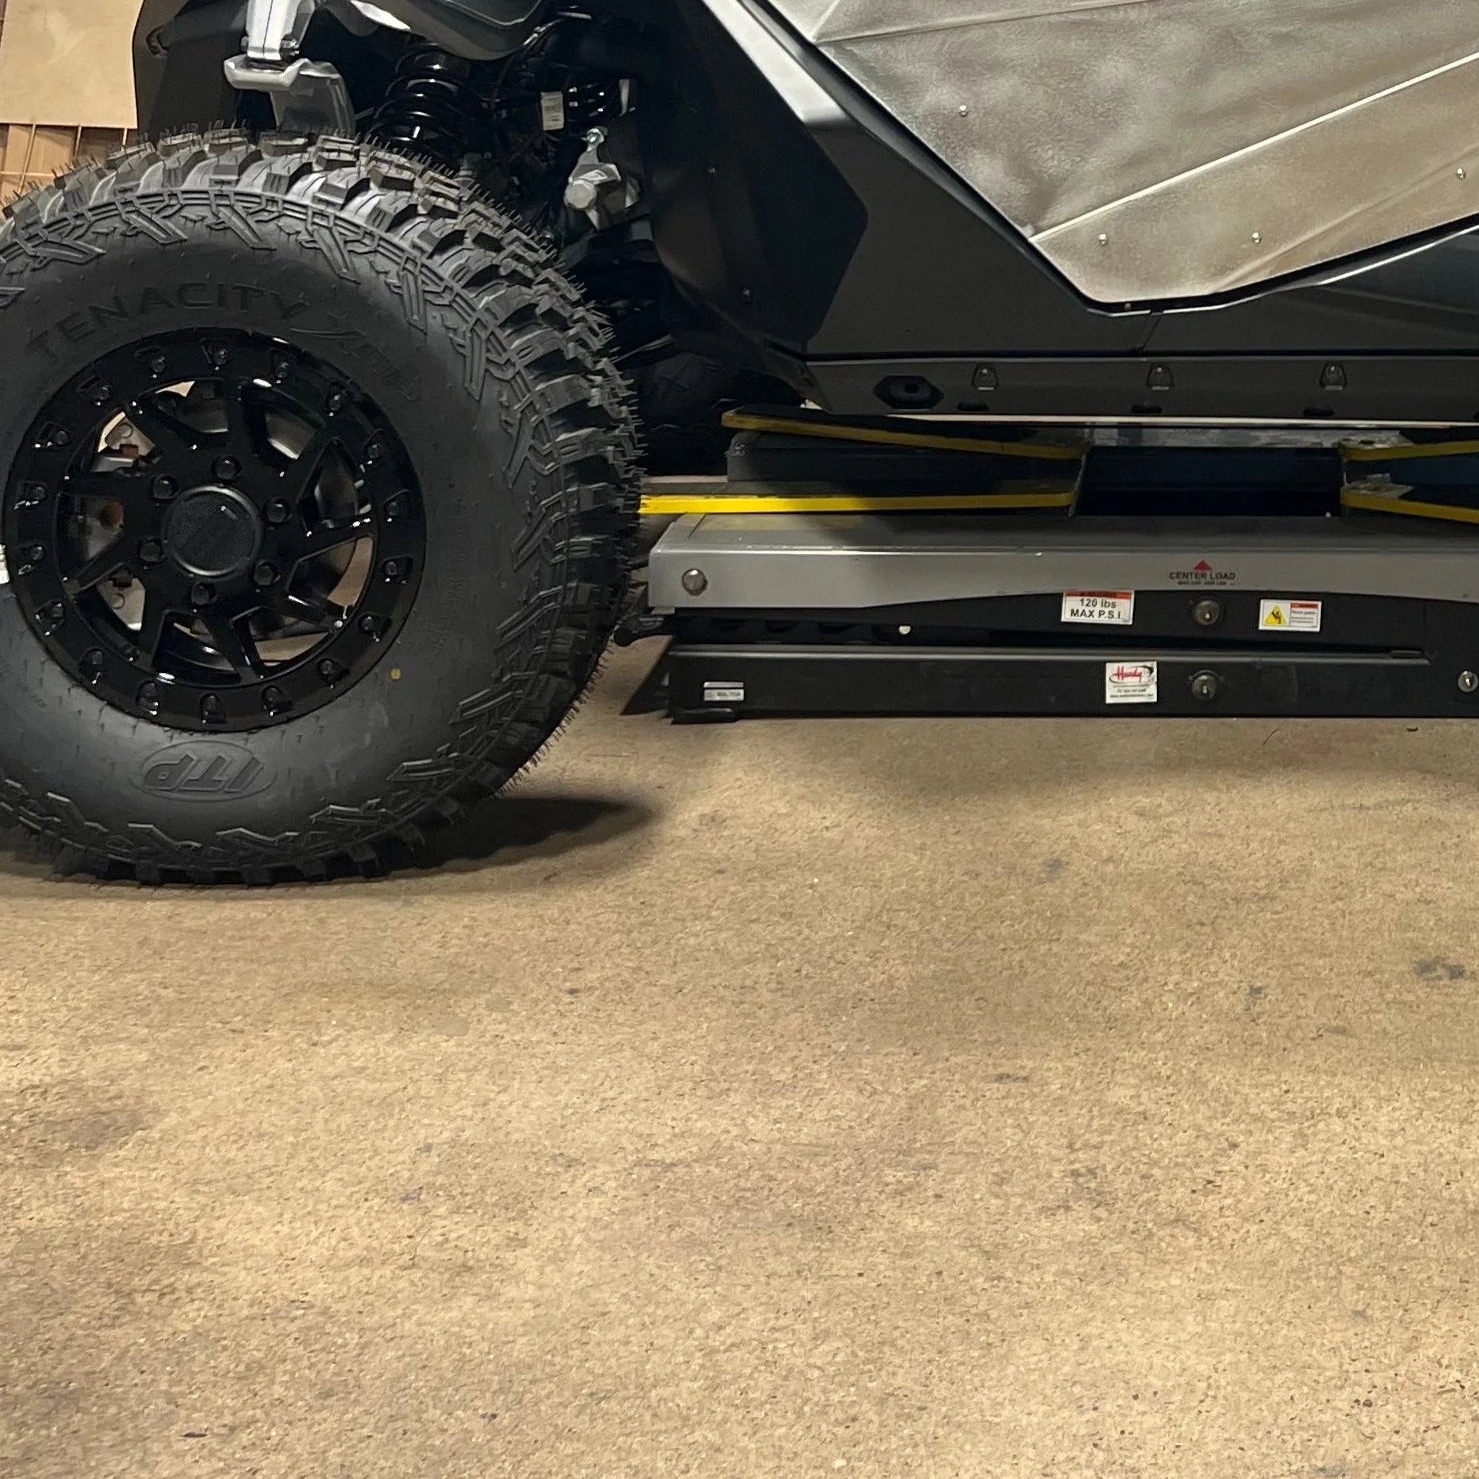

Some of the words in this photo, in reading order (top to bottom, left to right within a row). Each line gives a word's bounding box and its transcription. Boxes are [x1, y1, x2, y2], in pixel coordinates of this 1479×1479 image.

[24, 281, 308, 364] TENACITY
[1169, 571, 1207, 581] CENTER
[1209, 571, 1236, 581] LOAD
[1080, 598, 1098, 608] 120
[1101, 599, 1117, 609] lbs
[1070, 609, 1095, 619] MAX
[143, 752, 265, 794] ITP
